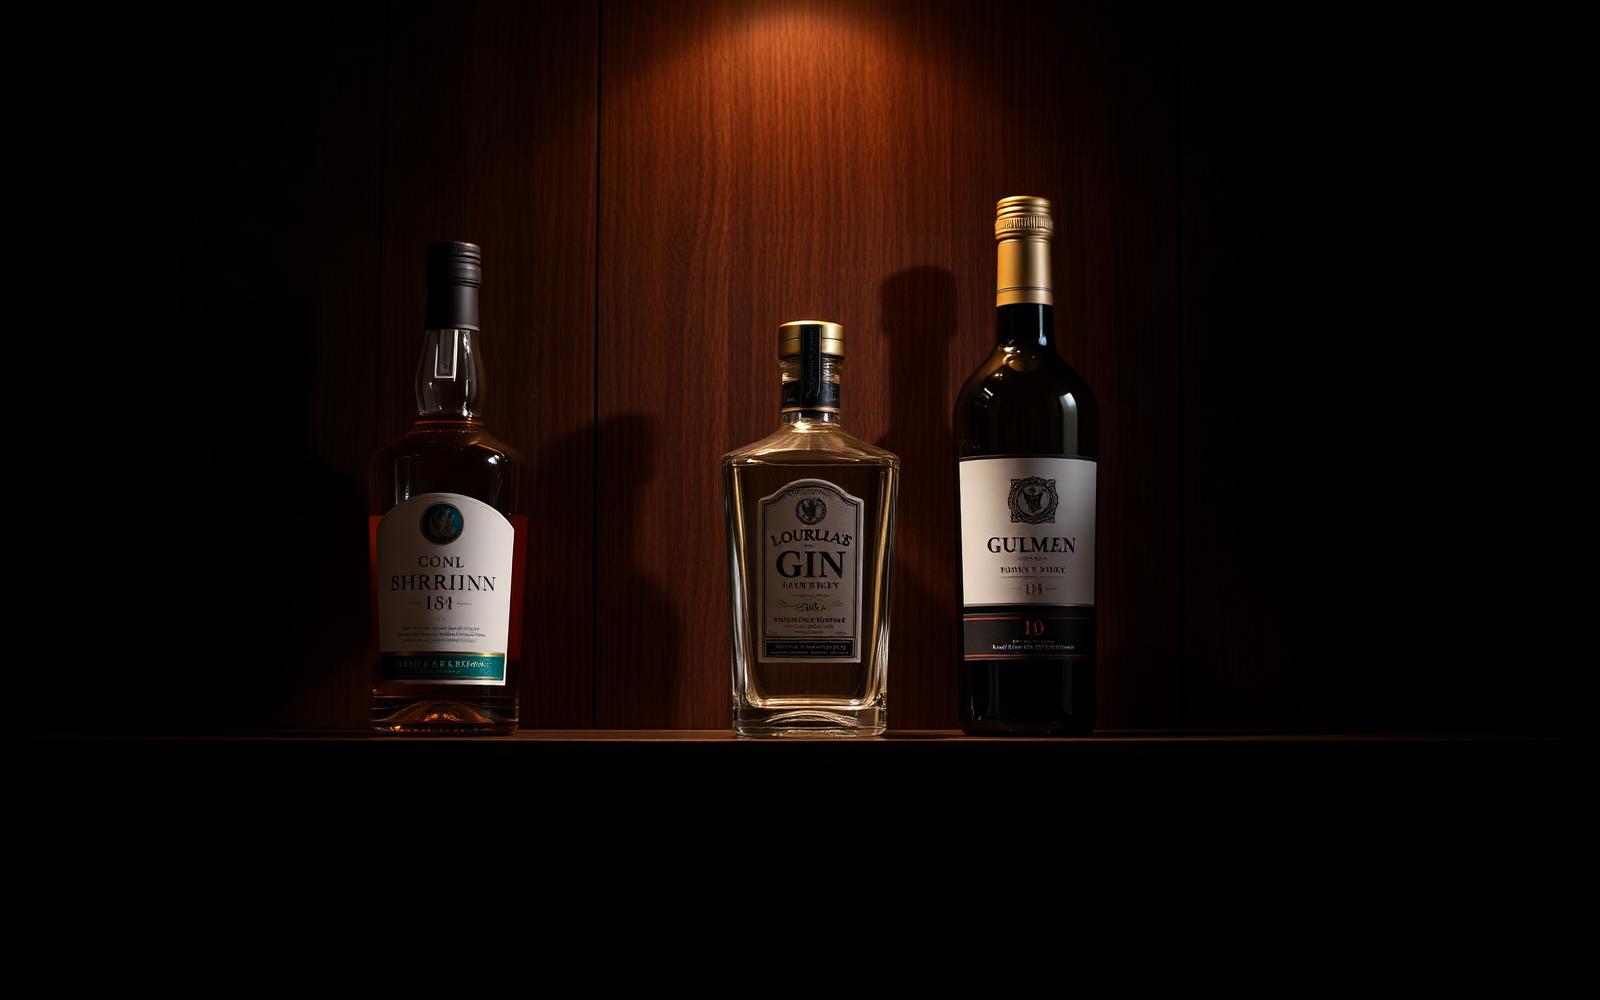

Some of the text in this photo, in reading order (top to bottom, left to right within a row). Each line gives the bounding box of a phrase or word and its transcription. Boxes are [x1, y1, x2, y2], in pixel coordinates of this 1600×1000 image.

[987, 536, 1076, 553] GULMEN
[418, 555, 465, 568] CONL
[776, 551, 846, 578] GIN
